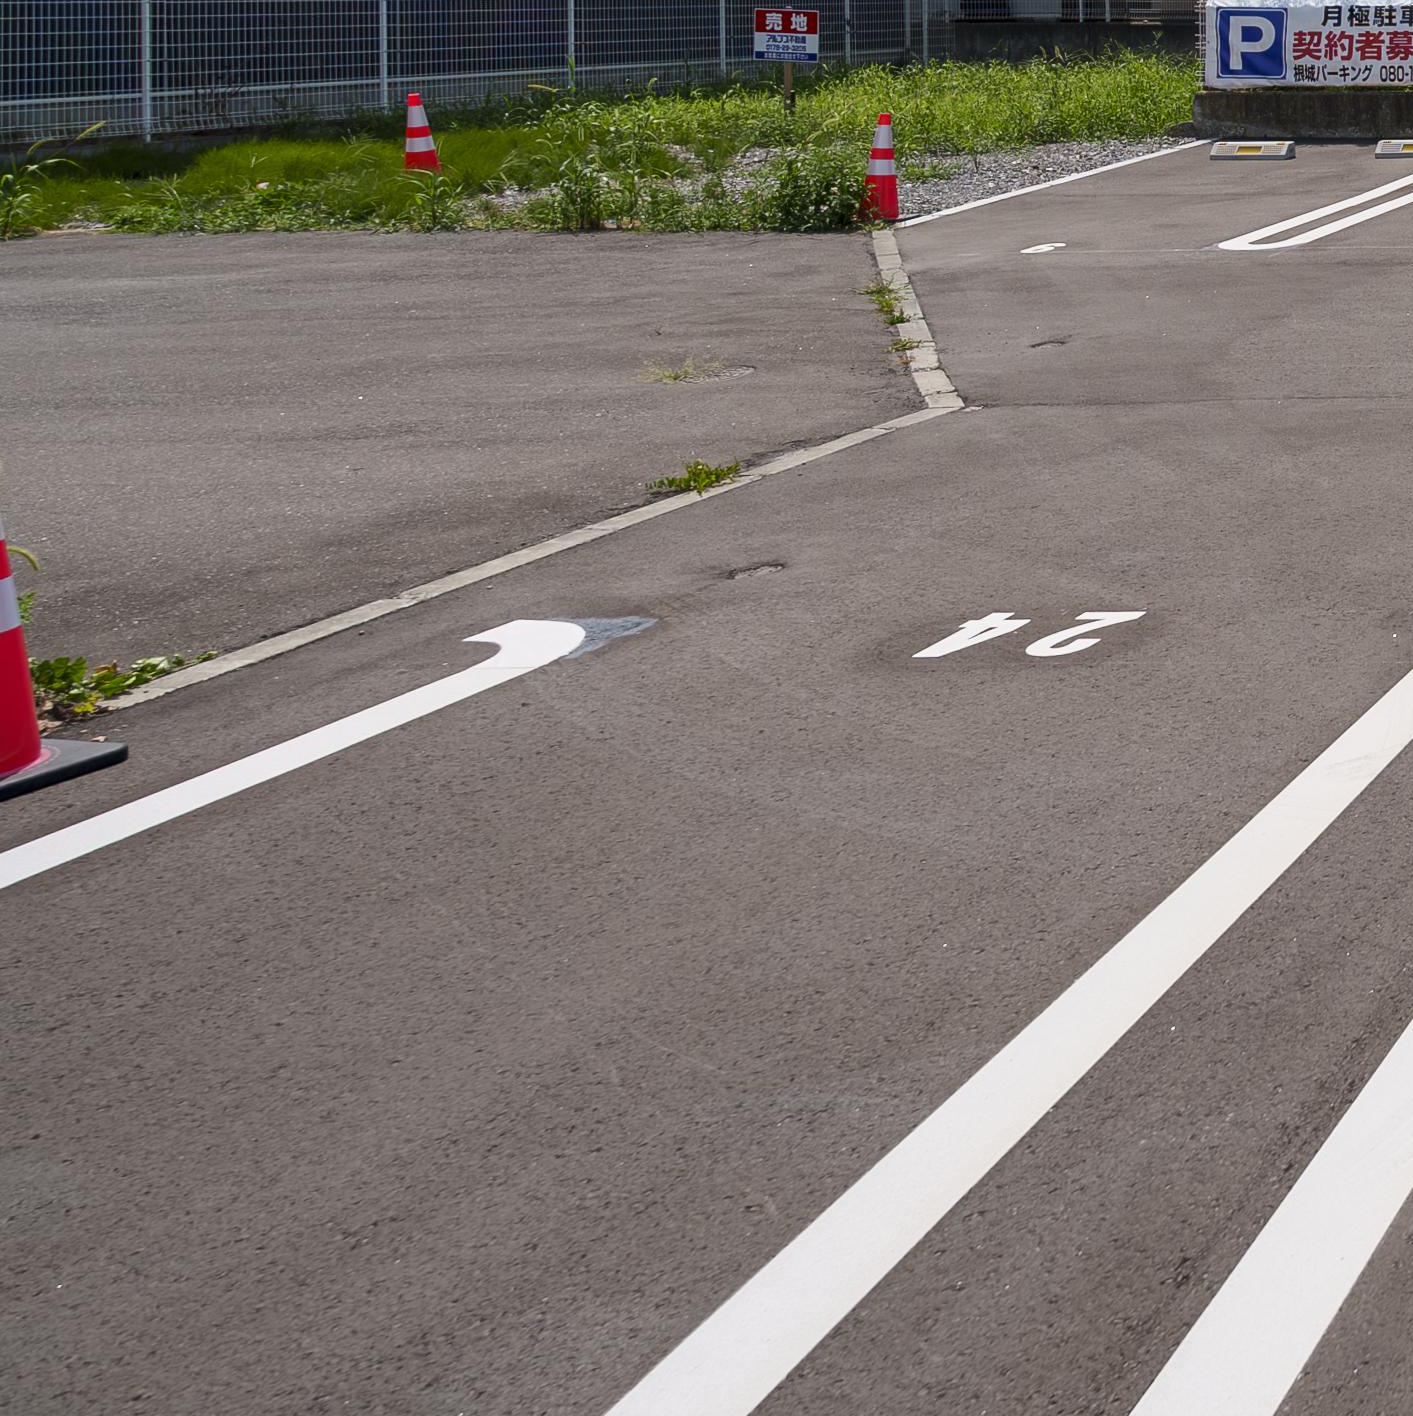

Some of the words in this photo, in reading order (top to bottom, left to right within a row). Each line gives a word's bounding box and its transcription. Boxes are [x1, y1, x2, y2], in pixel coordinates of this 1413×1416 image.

[765, 12, 808, 32] 売地
[1229, 16, 1276, 70] P
[1293, 64, 1373, 83] 根城パーキング
[911, 611, 1147, 658] 24
